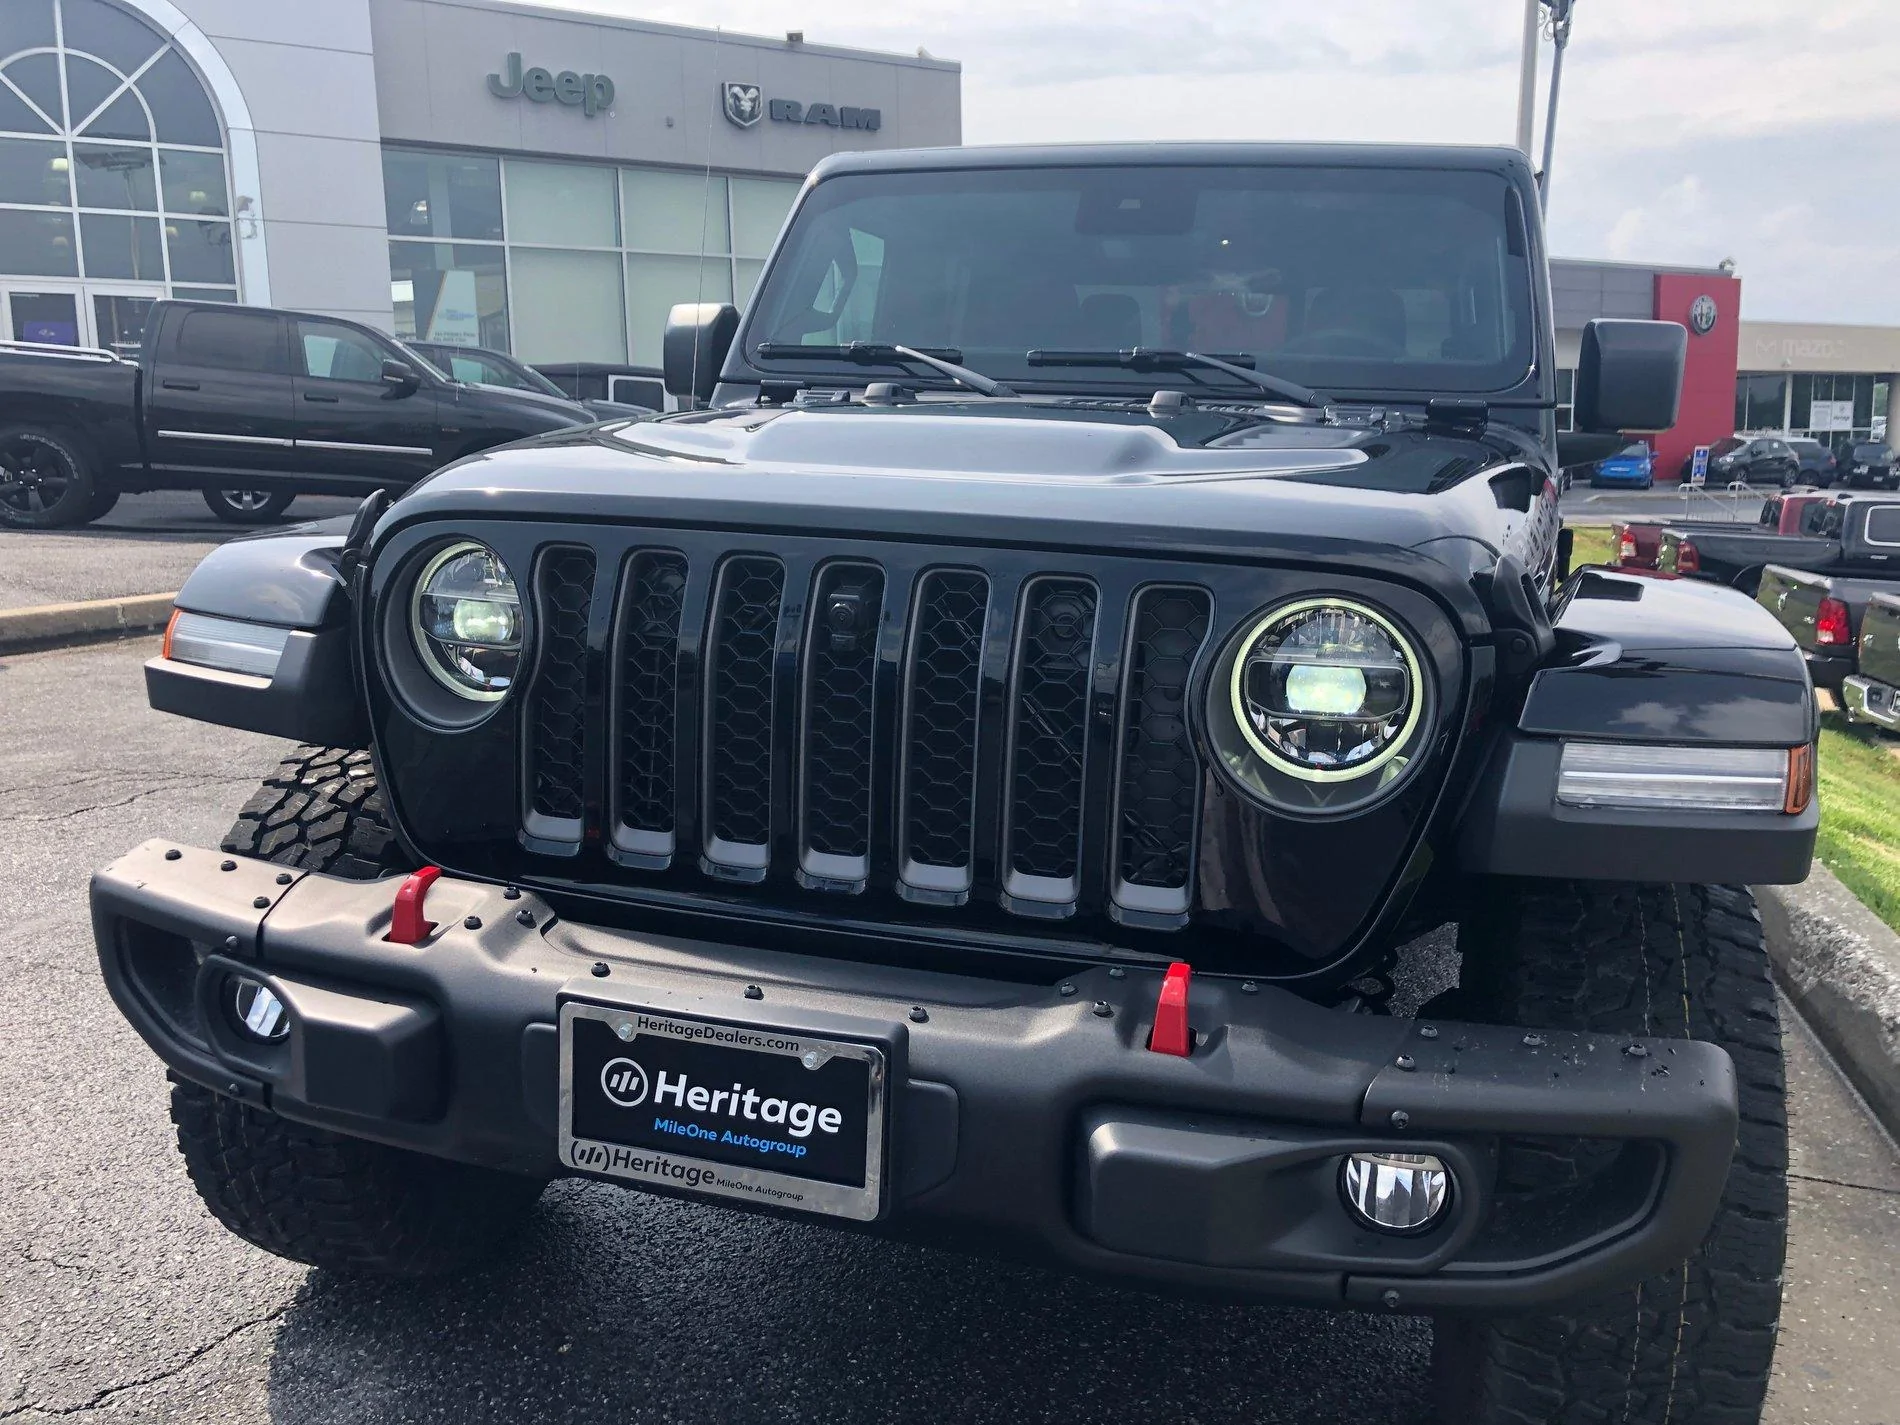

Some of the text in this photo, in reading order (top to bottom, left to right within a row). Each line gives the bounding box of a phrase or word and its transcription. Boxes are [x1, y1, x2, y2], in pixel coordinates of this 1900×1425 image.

[486, 52, 615, 117] Jeep
[769, 98, 881, 131] RAM
[637, 1016, 799, 1052] HeritageDealers.com
[653, 1070, 842, 1138] Heritage
[653, 1117, 807, 1157] MileOne Autogroup
[612, 1148, 804, 1202] Heritage MileOne Autogroup
